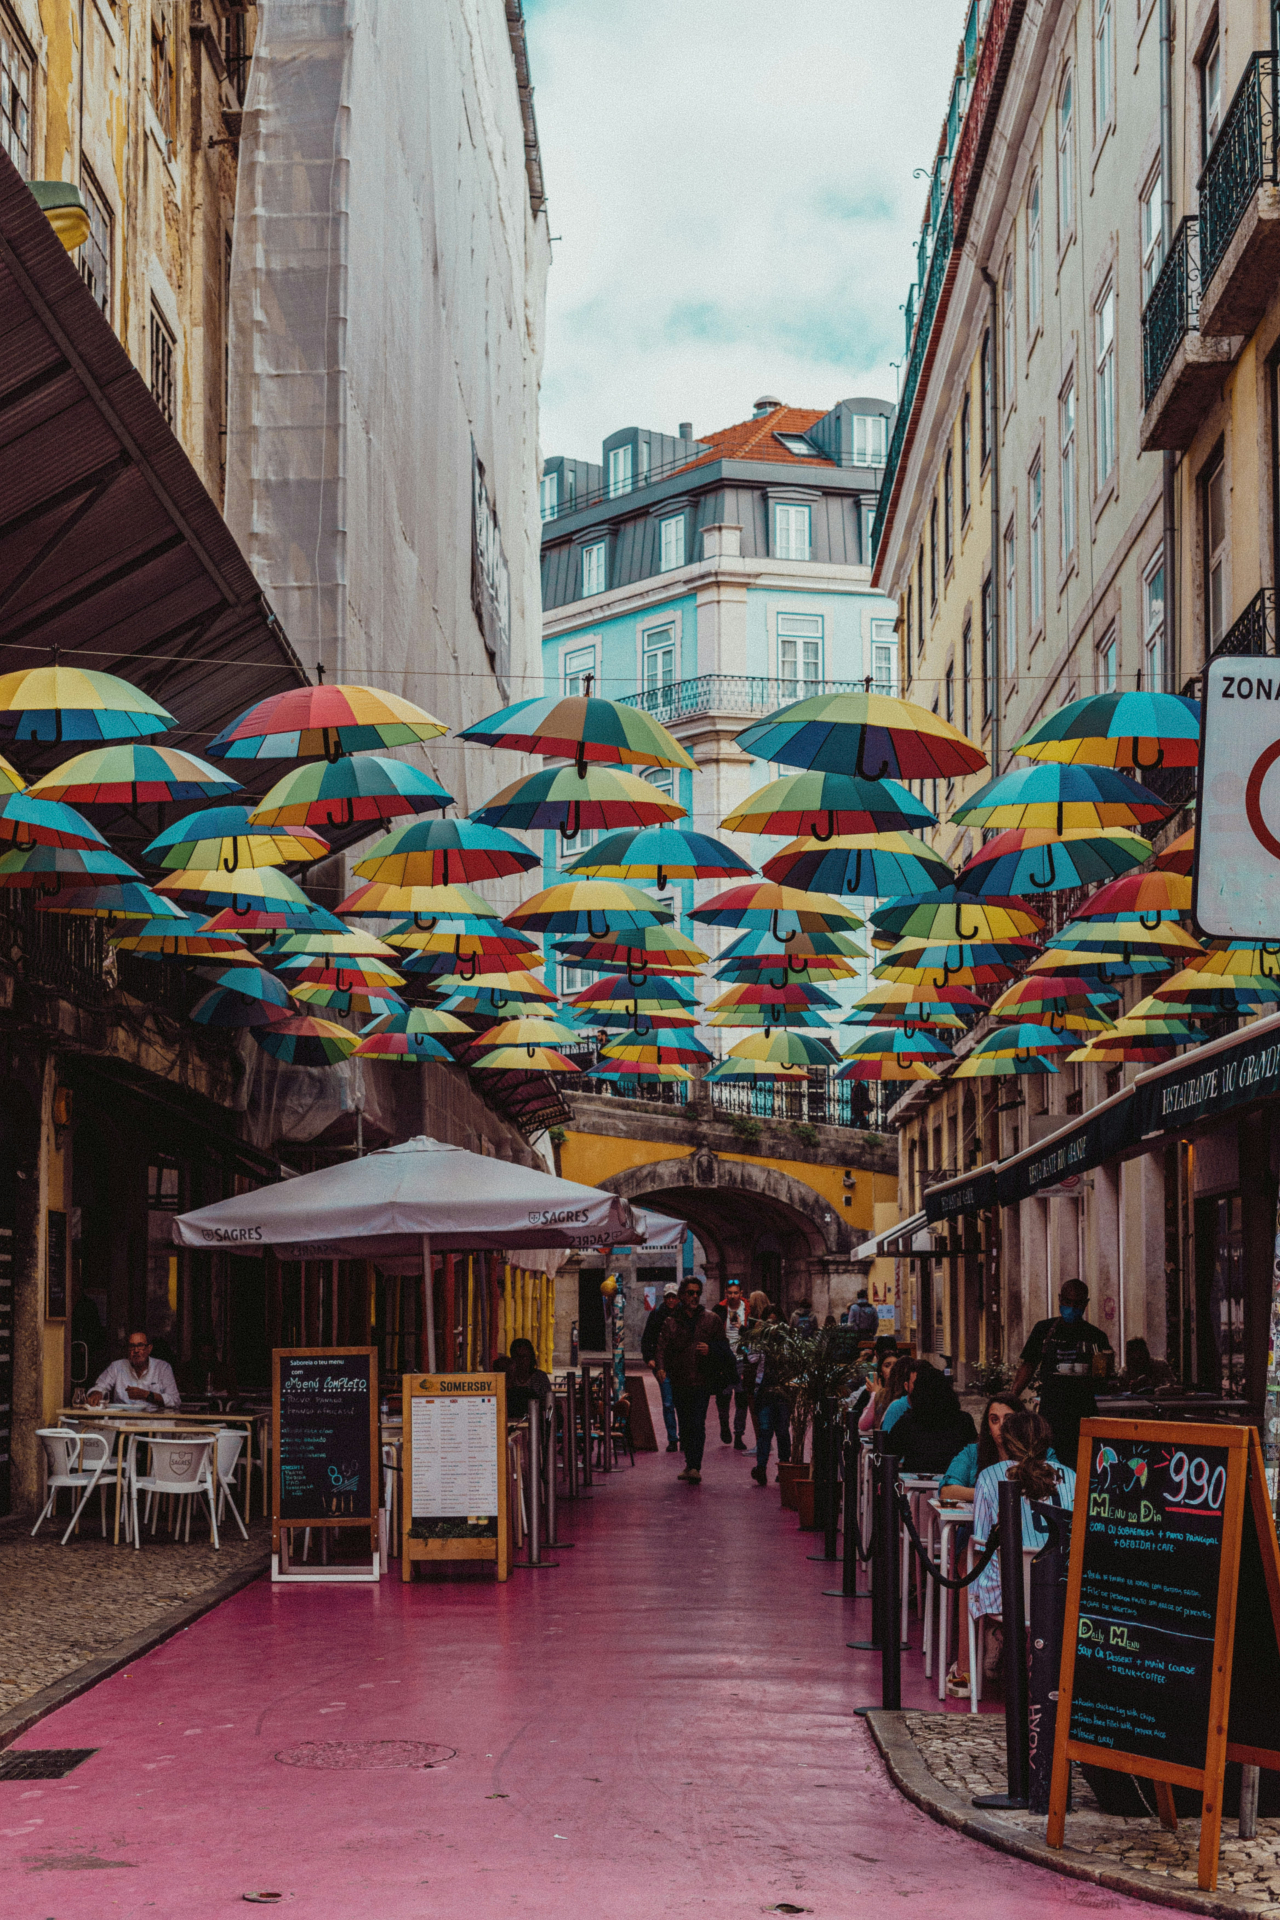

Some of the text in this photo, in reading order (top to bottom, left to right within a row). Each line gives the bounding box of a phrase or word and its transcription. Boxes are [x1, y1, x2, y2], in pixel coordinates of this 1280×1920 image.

[541, 1209, 589, 1225] SAGRES
[215, 1226, 263, 1242] SAGRES
[440, 1381, 492, 1393] SOMERSBY
[1107, 1524, 1116, 1535] OU
[1117, 1525, 1154, 1537] SOBREMESA
[1167, 1663, 1196, 1675] COURSE
